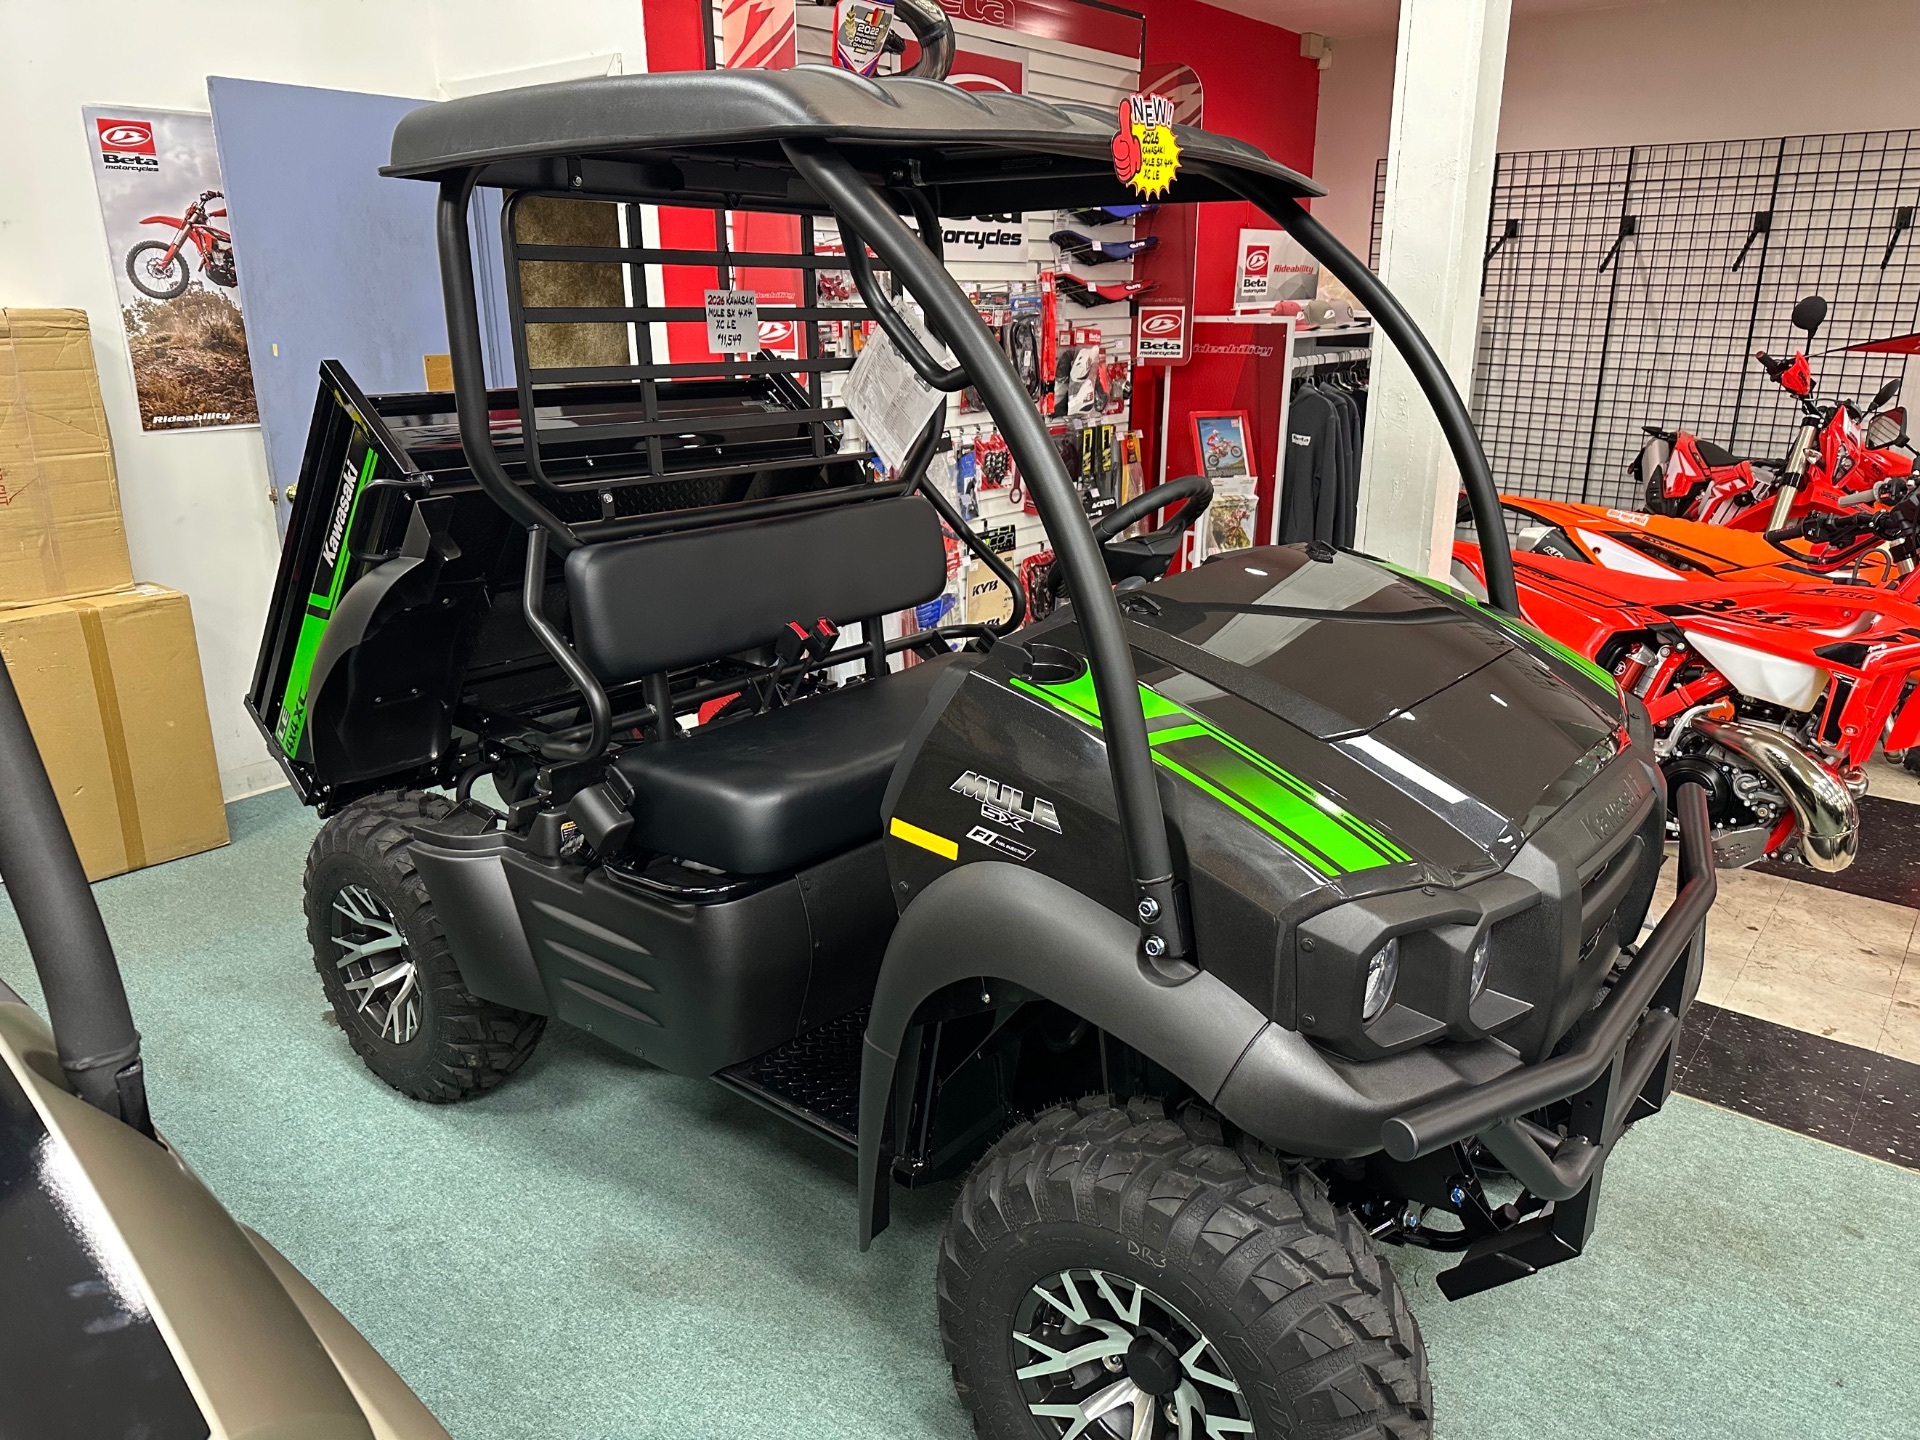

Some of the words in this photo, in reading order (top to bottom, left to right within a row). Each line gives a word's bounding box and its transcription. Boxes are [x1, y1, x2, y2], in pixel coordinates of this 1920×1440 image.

[857, 23, 880, 35] 2022
[854, 36, 876, 45] OVERALL
[1131, 95, 1174, 128] NEW!
[1142, 131, 1159, 144] 2026
[102, 153, 159, 166] Beta
[1142, 157, 1155, 166] MULE
[105, 164, 159, 173] motorcycles
[1144, 169, 1151, 180] XC
[1152, 170, 1160, 180] LE
[939, 227, 1022, 250] orcycles
[1273, 264, 1314, 275] Rideability
[1243, 279, 1267, 288] Beta
[707, 294, 725, 305] 2026
[726, 295, 755, 306] KAWASAKI
[708, 307, 725, 318] MULE
[727, 308, 736, 318] SX
[716, 319, 725, 330] XC
[726, 319, 737, 330] LE
[1139, 341, 1181, 350] Beta
[1193, 343, 1274, 357] ideability
[152, 412, 231, 424] Rideability
[322, 459, 359, 569] Kawasaki
[972, 580, 999, 597] KYB
[278, 706, 291, 741] LE
[950, 770, 1063, 835] MULE
[980, 803, 1025, 834] SX
[971, 828, 993, 842] FI
